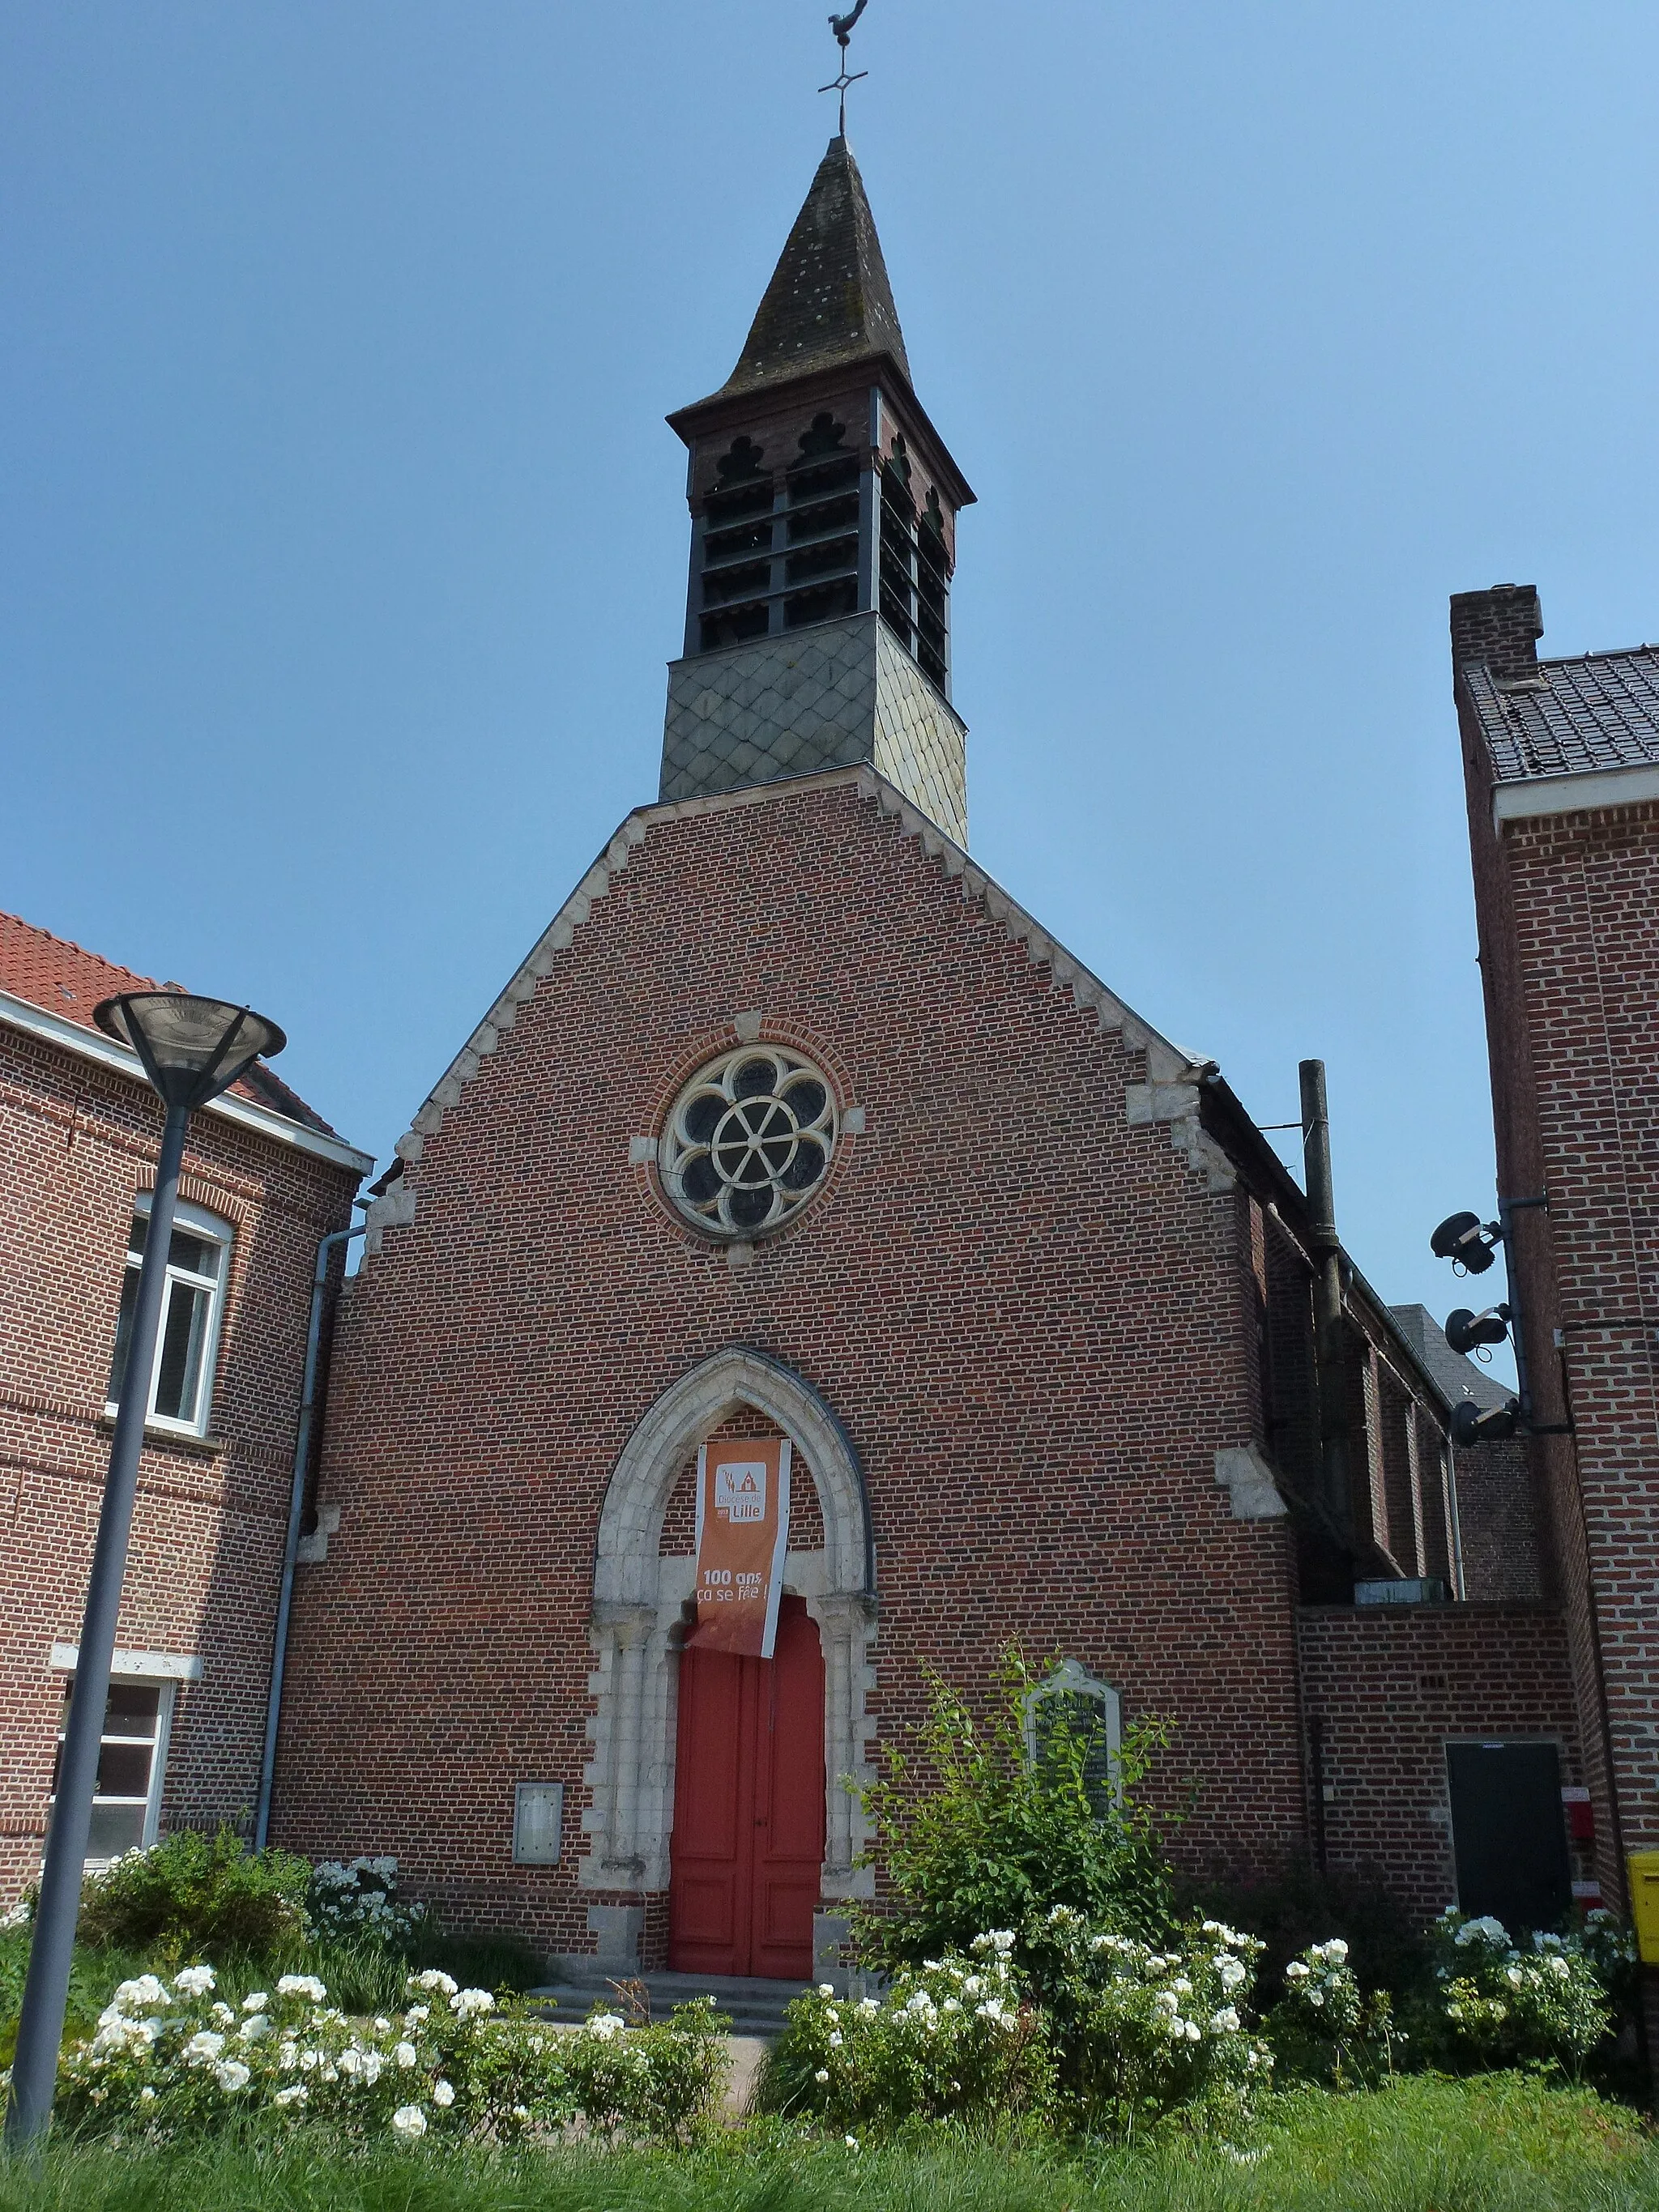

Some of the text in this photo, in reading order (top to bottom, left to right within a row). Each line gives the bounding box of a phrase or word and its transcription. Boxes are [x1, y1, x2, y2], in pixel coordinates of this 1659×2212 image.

[751, 1494, 761, 1502] de
[733, 1504, 760, 1517] Lille
[704, 1570, 762, 1585] 100 ans
[697, 1589, 712, 1605] ça
[716, 1589, 734, 1601] se
